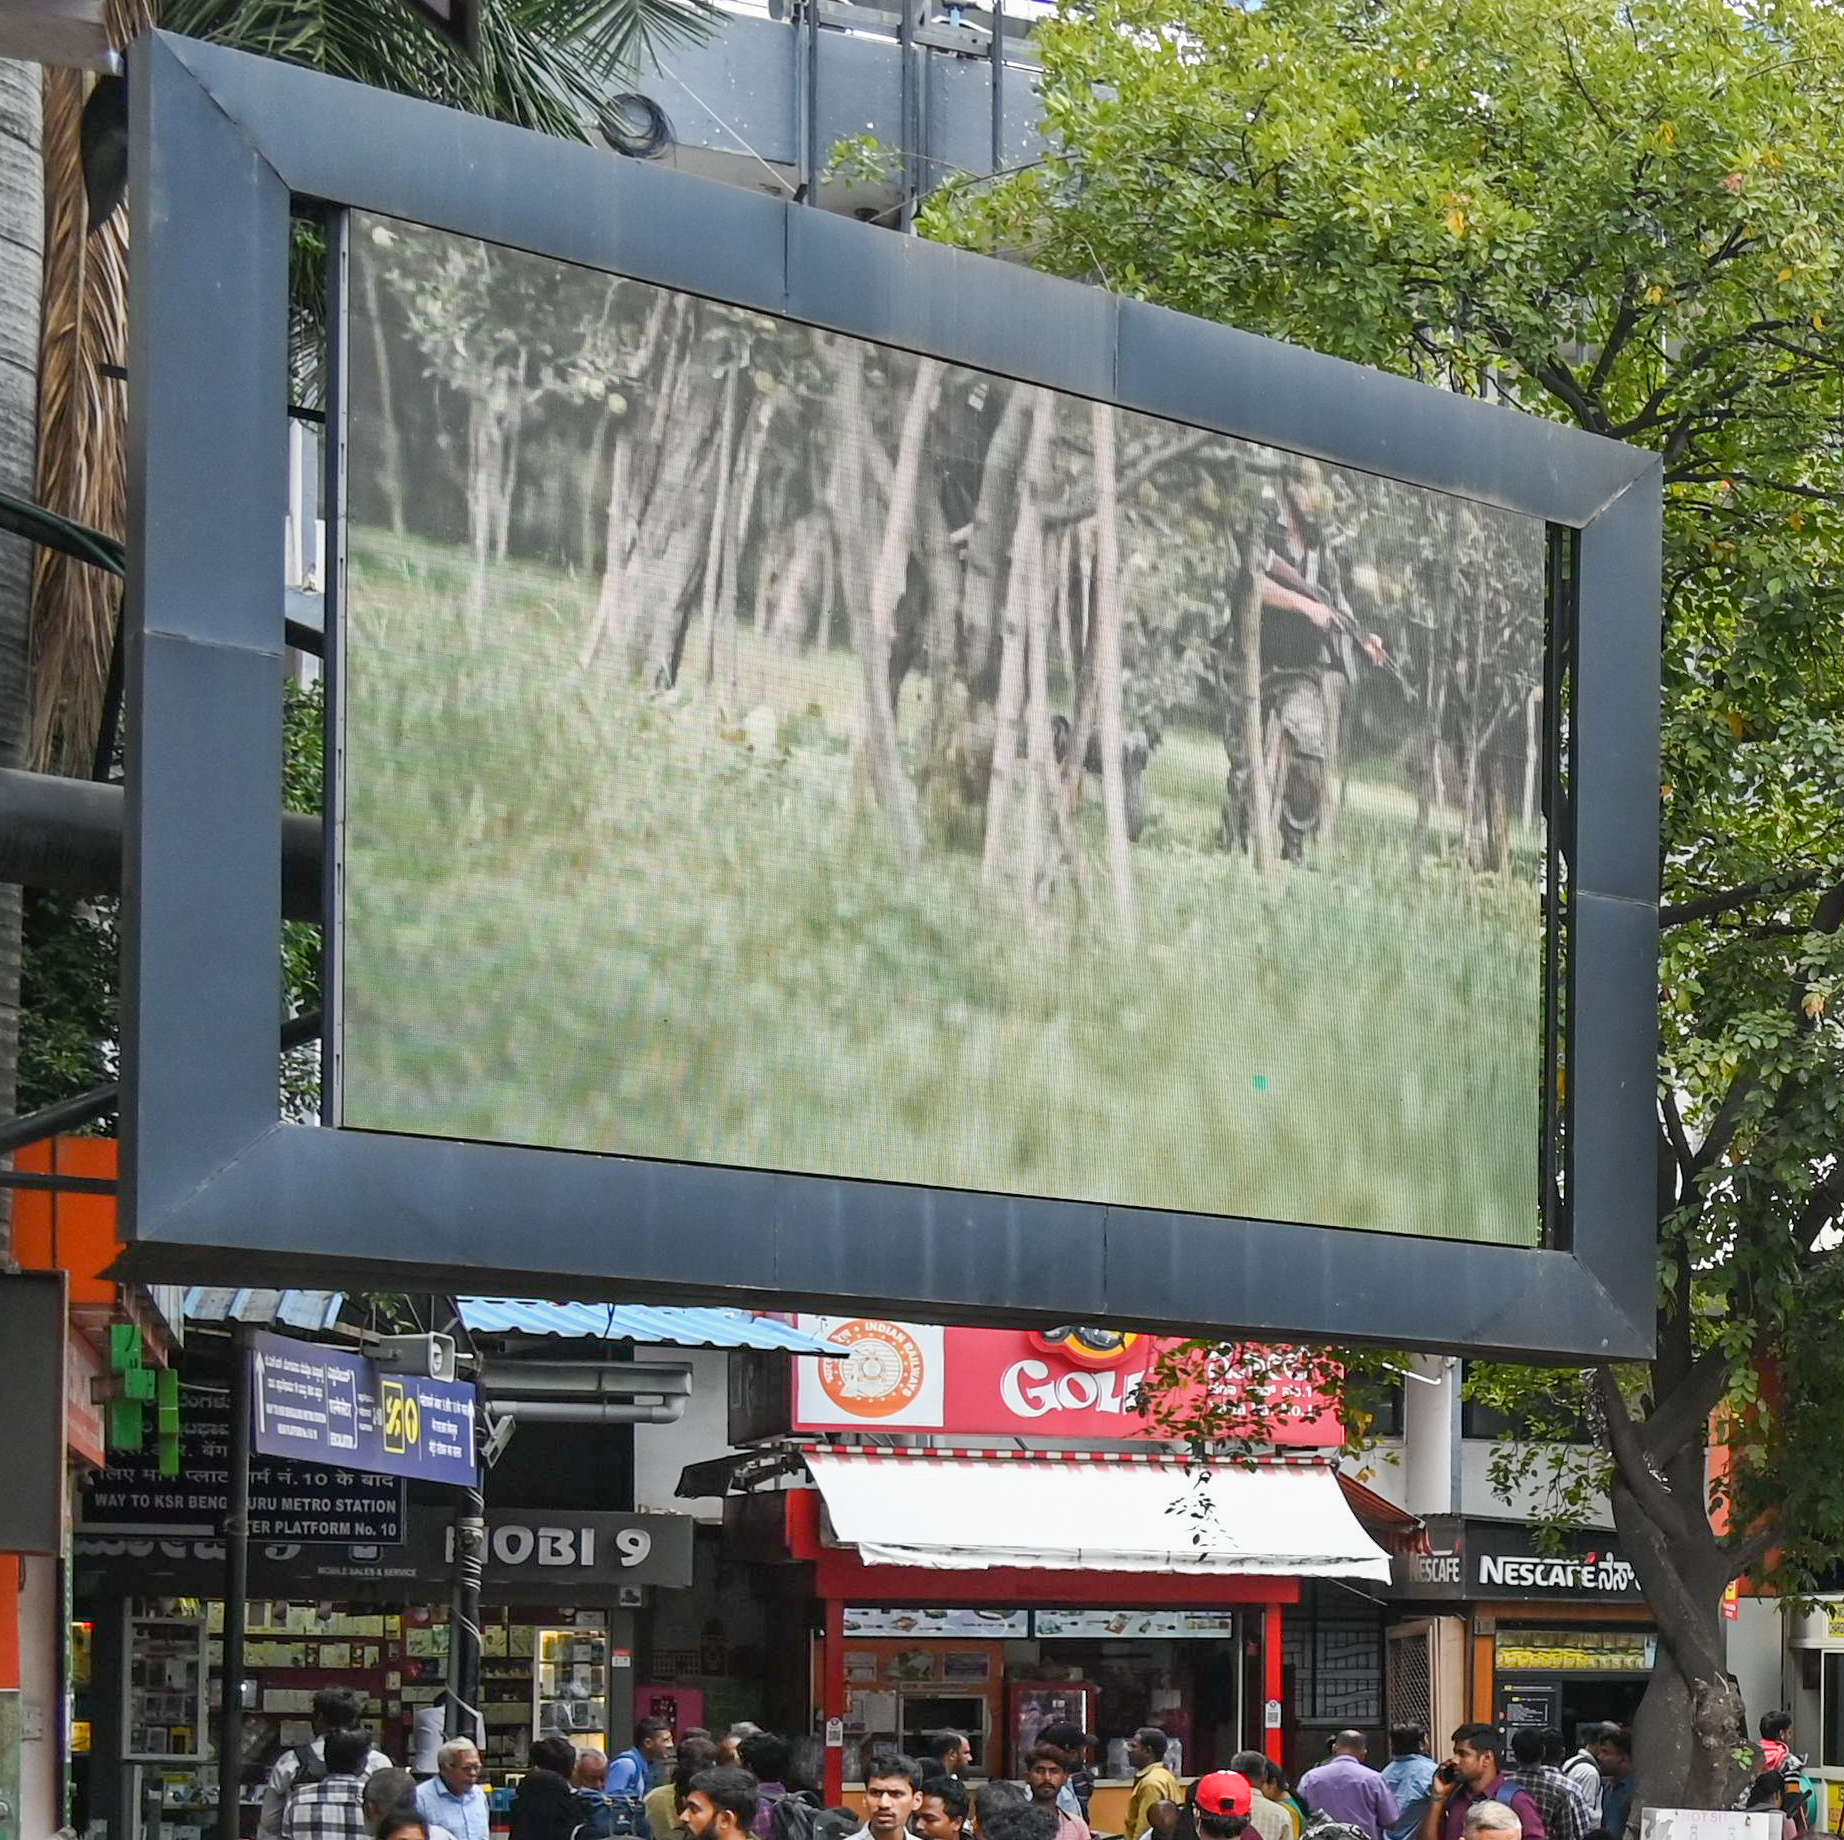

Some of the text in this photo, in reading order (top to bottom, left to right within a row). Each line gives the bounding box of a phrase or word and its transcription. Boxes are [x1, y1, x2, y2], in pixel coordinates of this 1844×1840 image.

[865, 1322, 921, 1398] INDIAN RAILWAYS
[303, 1473, 328, 1485] 10
[337, 1469, 357, 1487] के
[361, 1472, 394, 1488] बाद
[95, 1493, 396, 1514] WAY TO KSR BENGURU METRO STATION
[274, 1521, 397, 1537] PLATFORM No. 10
[615, 1528, 651, 1567] 9
